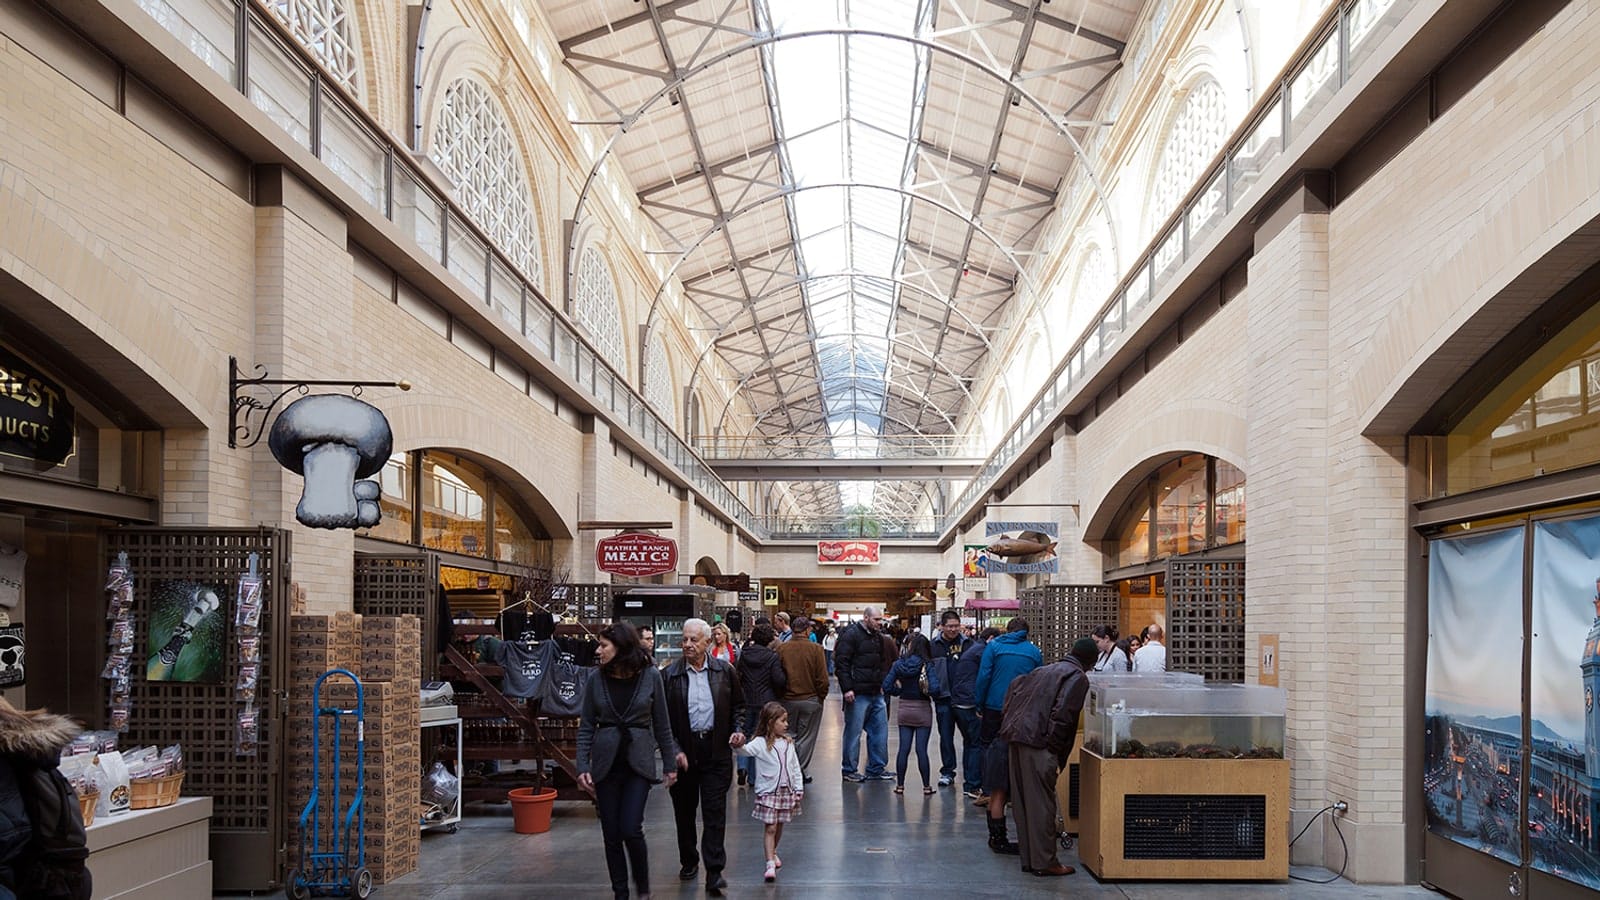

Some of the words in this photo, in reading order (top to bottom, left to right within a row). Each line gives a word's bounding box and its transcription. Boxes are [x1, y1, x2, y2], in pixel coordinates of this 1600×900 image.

[0, 416, 49, 442] UCTS
[986, 522, 1006, 535] SAN
[1007, 522, 1058, 537] FRANCISCO
[605, 552, 647, 561] MEAT
[1008, 558, 1055, 573] COMPANY
